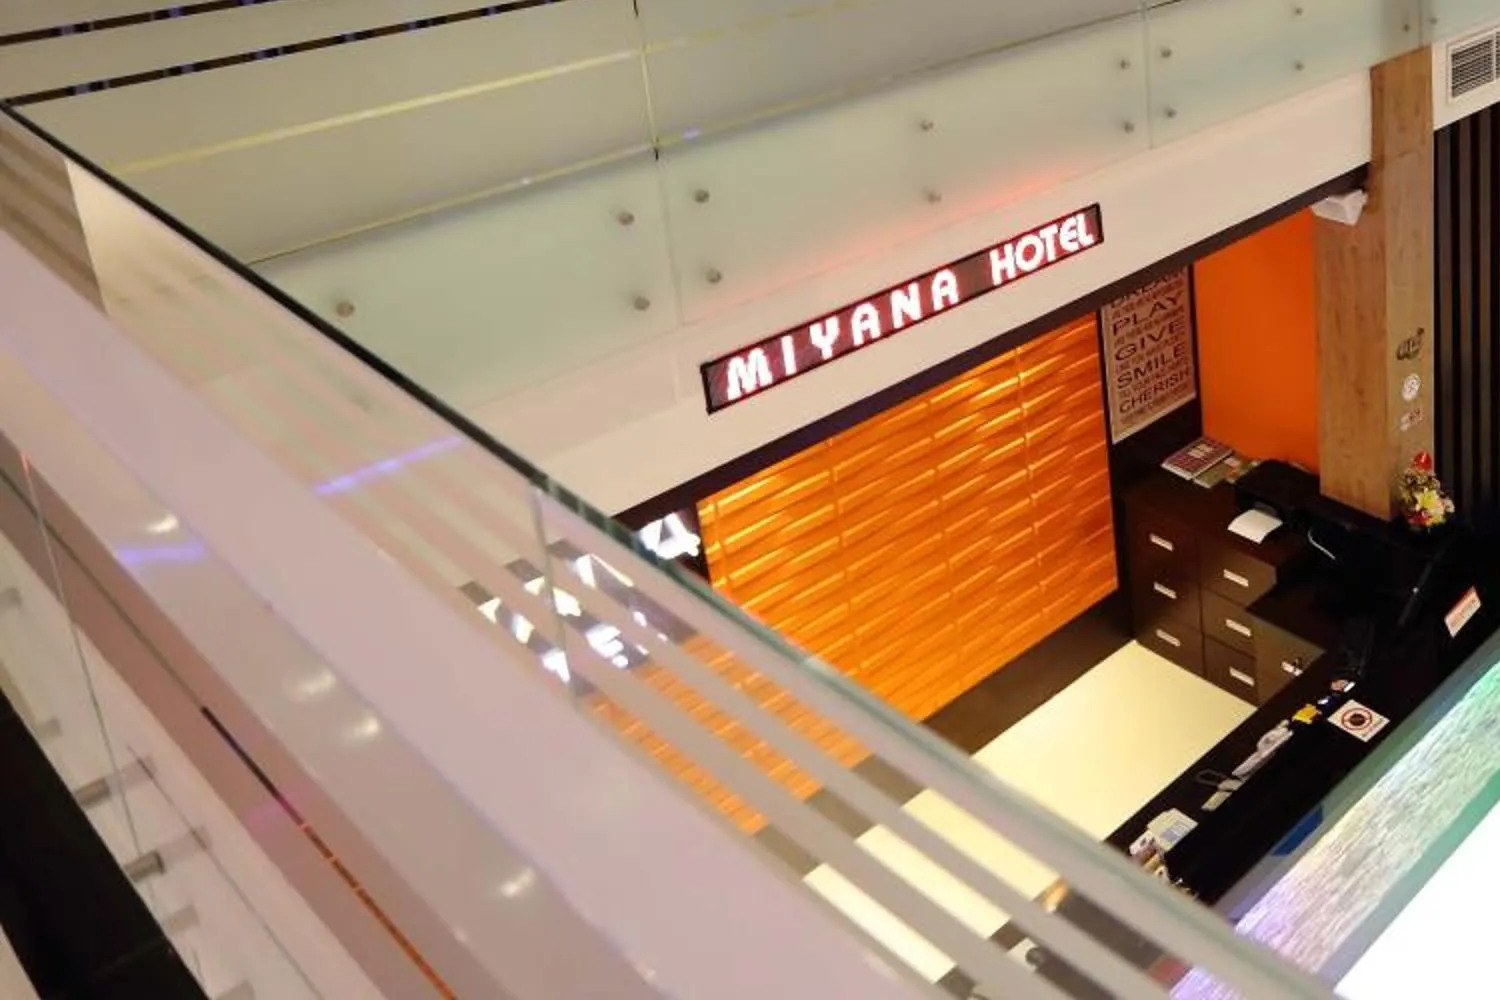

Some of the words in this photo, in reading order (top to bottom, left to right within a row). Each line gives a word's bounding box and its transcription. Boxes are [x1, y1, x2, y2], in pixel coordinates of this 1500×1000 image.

[726, 268, 959, 400] MIYANA
[989, 213, 1096, 286] HOTEL
[1112, 290, 1184, 337] PLAY
[1115, 319, 1185, 361] GIVE
[1117, 343, 1185, 389] SMILE
[1119, 366, 1190, 413] CHERISH
